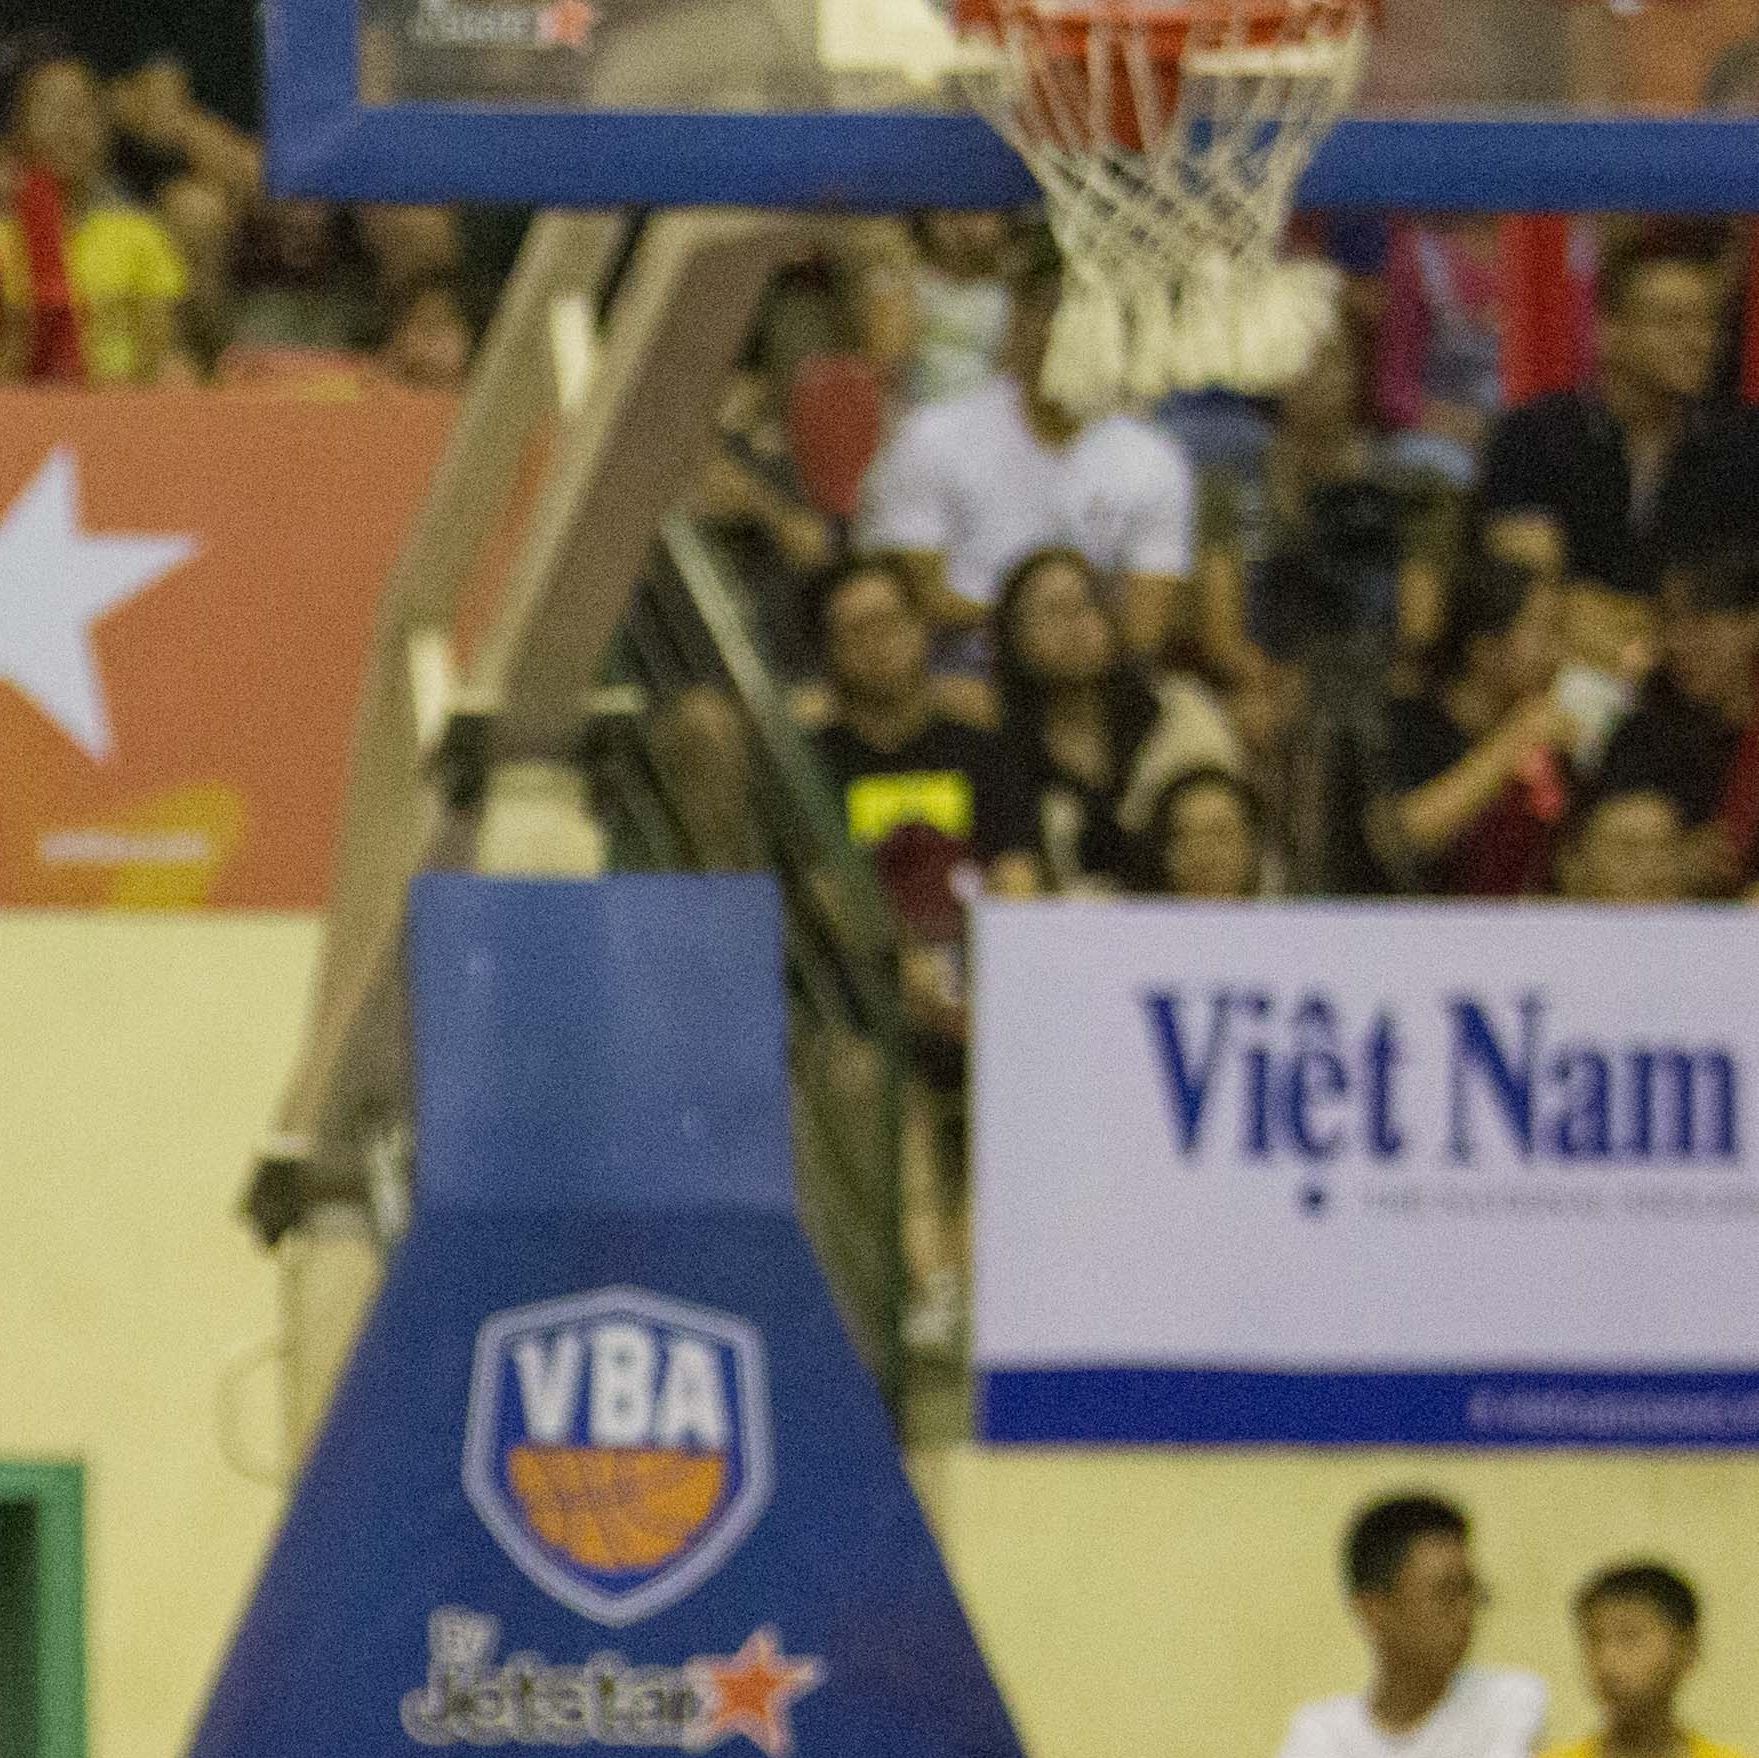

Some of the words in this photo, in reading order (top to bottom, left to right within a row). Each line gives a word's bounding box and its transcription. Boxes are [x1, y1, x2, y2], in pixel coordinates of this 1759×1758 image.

[1445, 978, 1739, 1166] Nam
[509, 1320, 732, 1447] VBA
[407, 1656, 702, 1743] Jetstar
